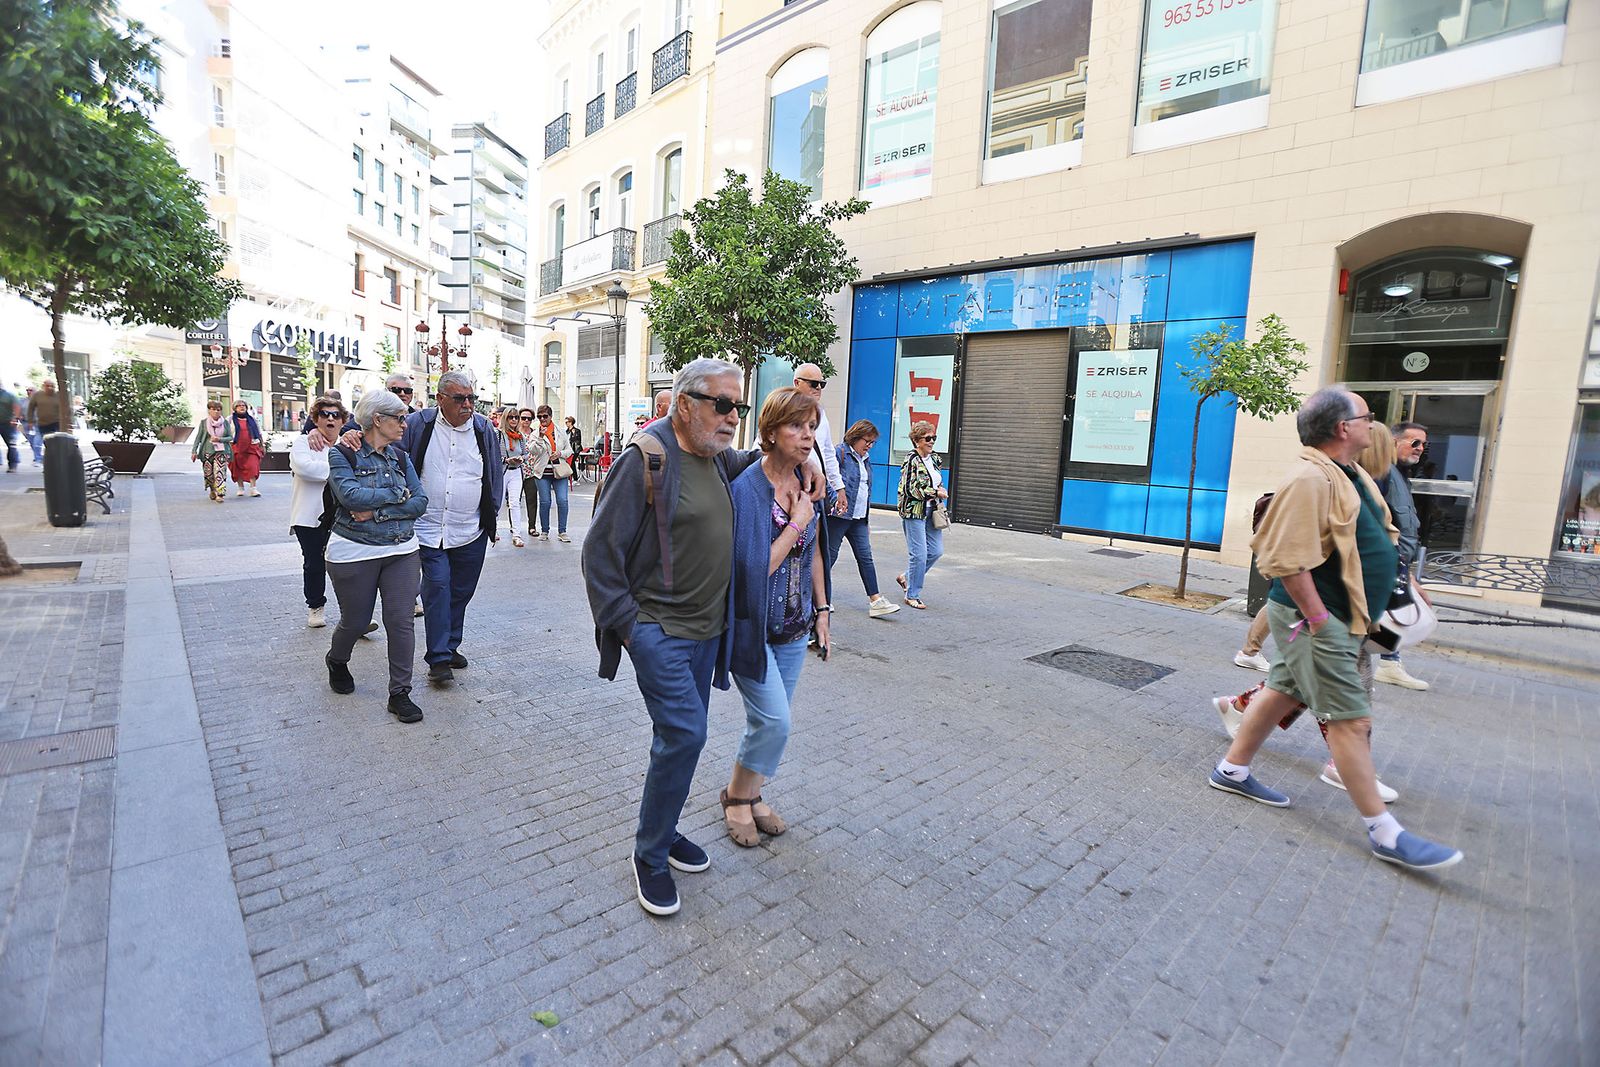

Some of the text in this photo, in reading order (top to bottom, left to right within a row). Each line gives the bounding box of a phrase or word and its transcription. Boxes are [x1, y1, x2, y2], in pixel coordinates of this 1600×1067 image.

[1164, 3, 1192, 28] 963
[1195, 0, 1214, 18] 53
[1175, 58, 1251, 87] ZRISER
[876, 90, 928, 117] SE ALQUILA
[883, 143, 927, 163] ZRISER
[186, 332, 226, 340] CORTEFIEL
[1097, 366, 1148, 376] ZRISER
[1086, 390, 1142, 400] SE ALQUILA
